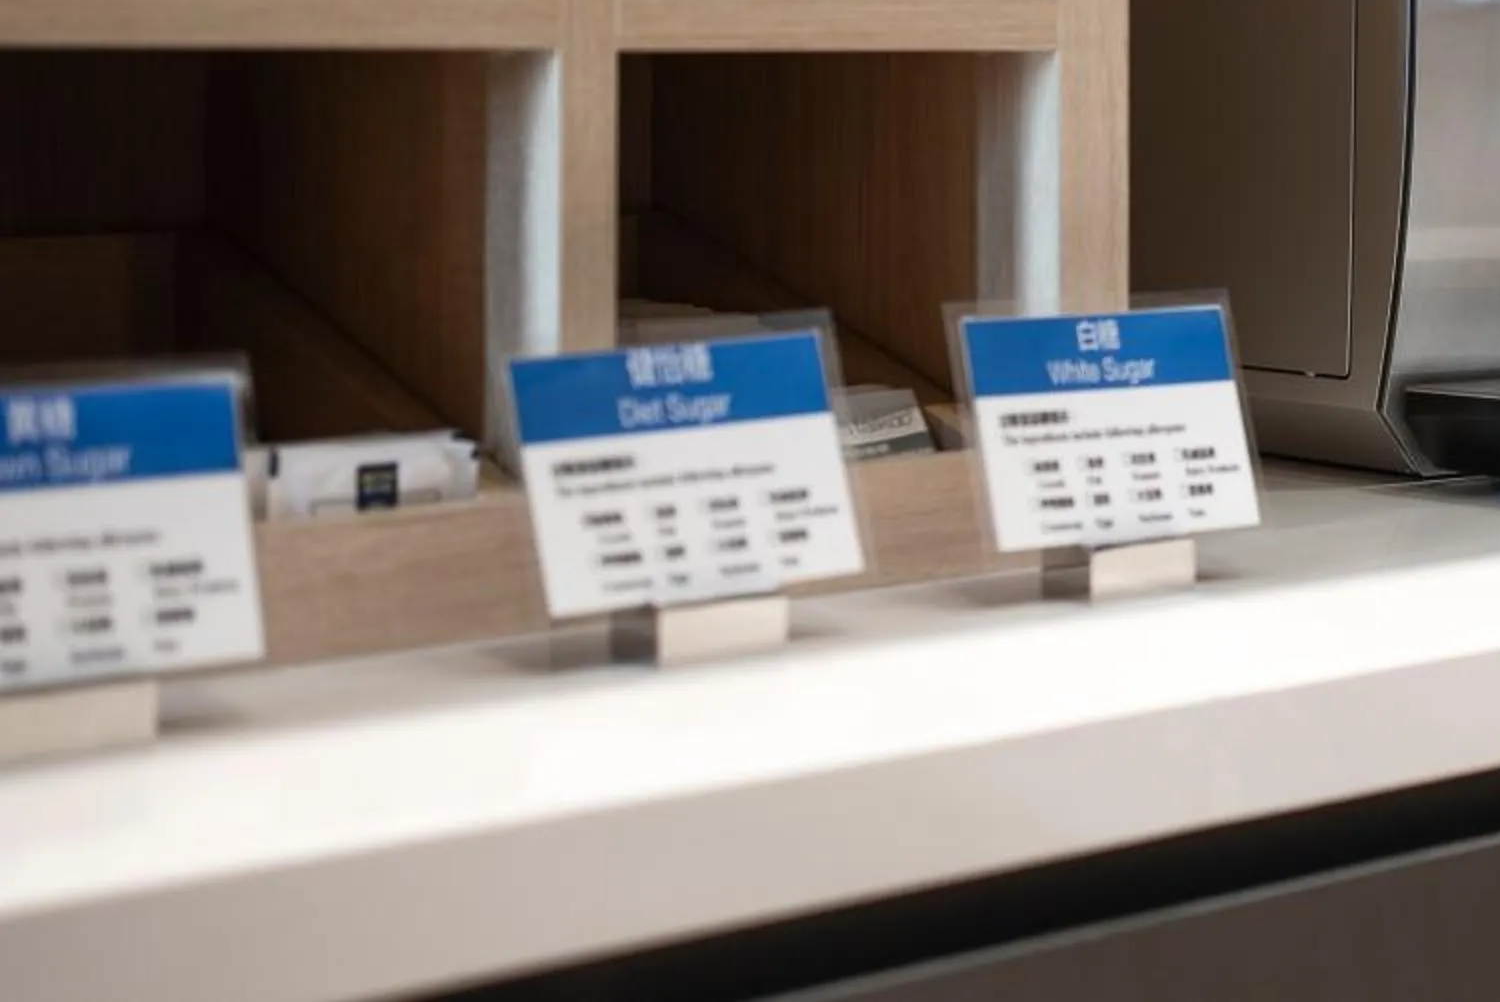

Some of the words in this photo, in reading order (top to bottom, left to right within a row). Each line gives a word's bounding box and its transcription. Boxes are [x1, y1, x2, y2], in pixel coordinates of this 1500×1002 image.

[1046, 359, 1100, 386] White
[1101, 356, 1155, 385] Sugar
[665, 391, 732, 423] Sugar
[43, 446, 132, 485] Sugar
